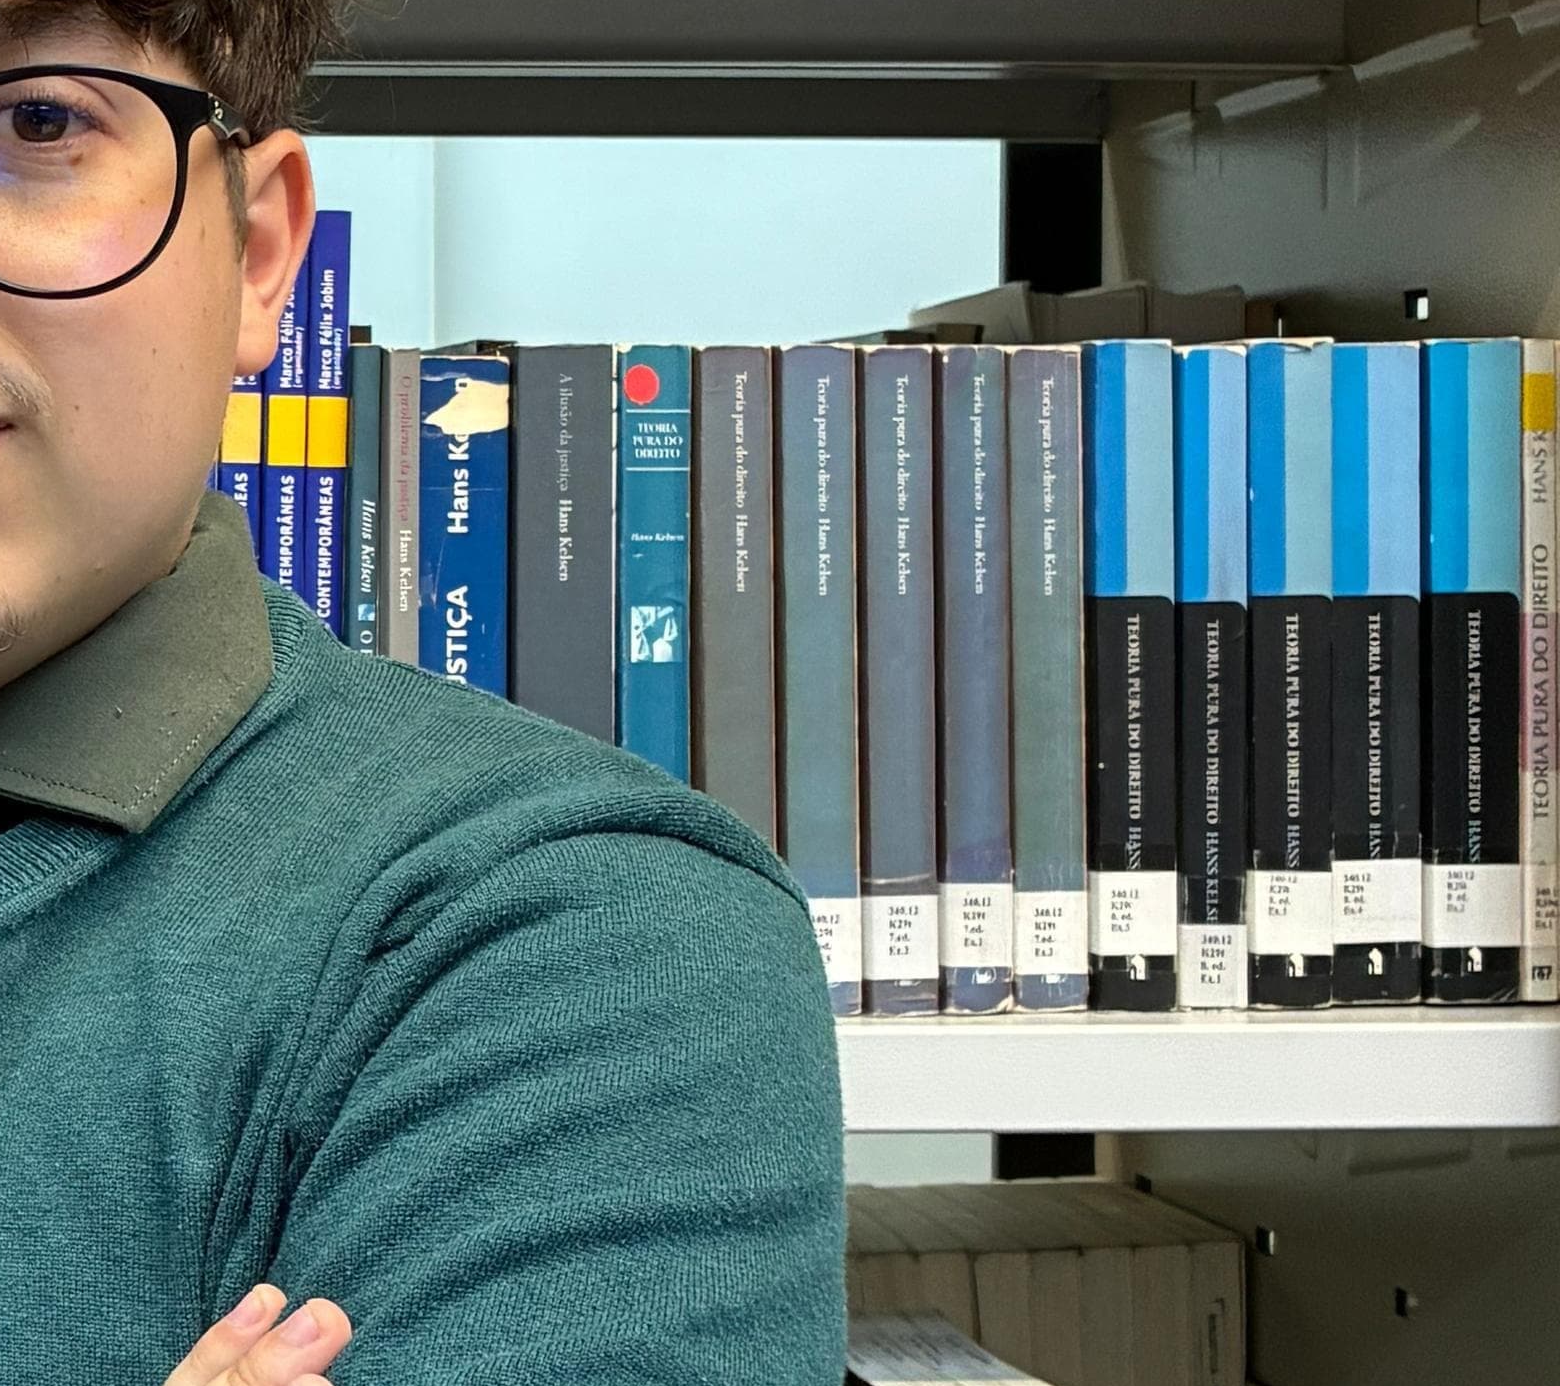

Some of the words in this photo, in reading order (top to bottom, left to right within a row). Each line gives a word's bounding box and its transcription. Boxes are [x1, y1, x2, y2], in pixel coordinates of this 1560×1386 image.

[320, 269, 335, 310] Jobim
[318, 313, 333, 346] Félix
[318, 348, 333, 390] Marco
[559, 373, 573, 384] A
[559, 388, 574, 427] ilusão
[817, 376, 830, 416] Teoria
[559, 429, 573, 446] da
[812, 417, 827, 448] pura
[555, 449, 572, 491] justiça
[818, 449, 831, 468] do
[1531, 447, 1549, 504] HANS
[446, 468, 469, 533] Hans
[817, 469, 831, 513] direito
[361, 499, 376, 540] Hans
[558, 499, 573, 534] Hans
[818, 518, 831, 551] Hans
[315, 476, 334, 618] CONTEMPORÂNEAS
[399, 529, 413, 563] Hans
[558, 537, 572, 582] Kelsen
[360, 544, 375, 593] Kelsen
[399, 567, 413, 612] Kelsen
[818, 553, 832, 596] Kelsen
[1531, 543, 1550, 630] DIREITO
[1206, 620, 1220, 680] TEORIA
[1532, 636, 1550, 673] DO
[1206, 683, 1220, 725] PURA
[1532, 678, 1550, 738] PURA
[1206, 728, 1219, 754] DO
[1205, 757, 1219, 825] DIREITO
[1532, 742, 1550, 819] TEORIA
[1206, 831, 1219, 876] HANS
